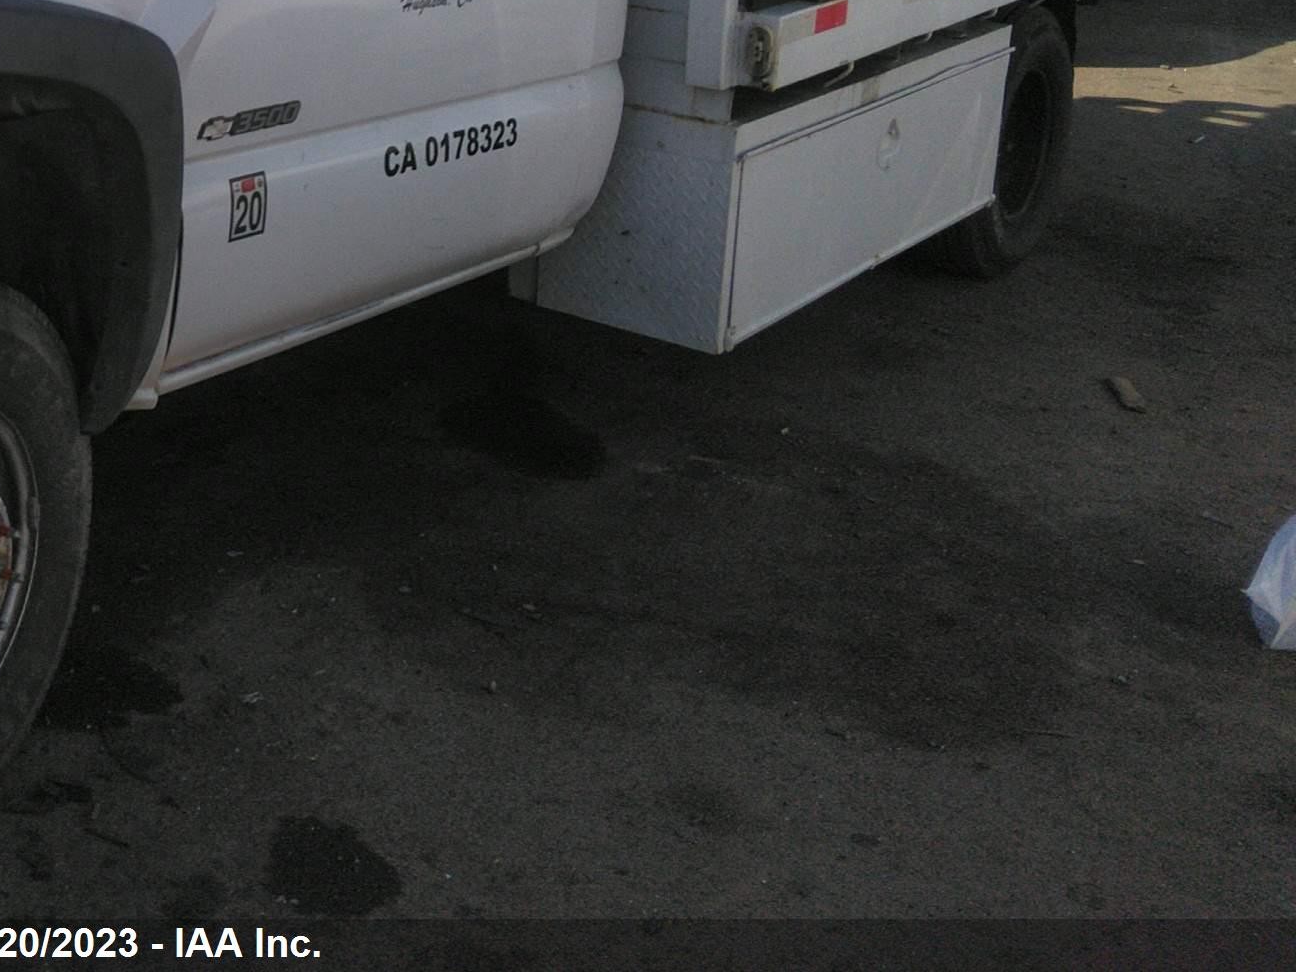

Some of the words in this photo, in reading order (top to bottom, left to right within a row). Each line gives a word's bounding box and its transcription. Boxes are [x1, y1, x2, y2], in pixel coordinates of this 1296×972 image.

[238, 101, 300, 133] 3500
[384, 144, 418, 177] CA
[425, 118, 518, 167] 0178323
[234, 191, 262, 235] 20
